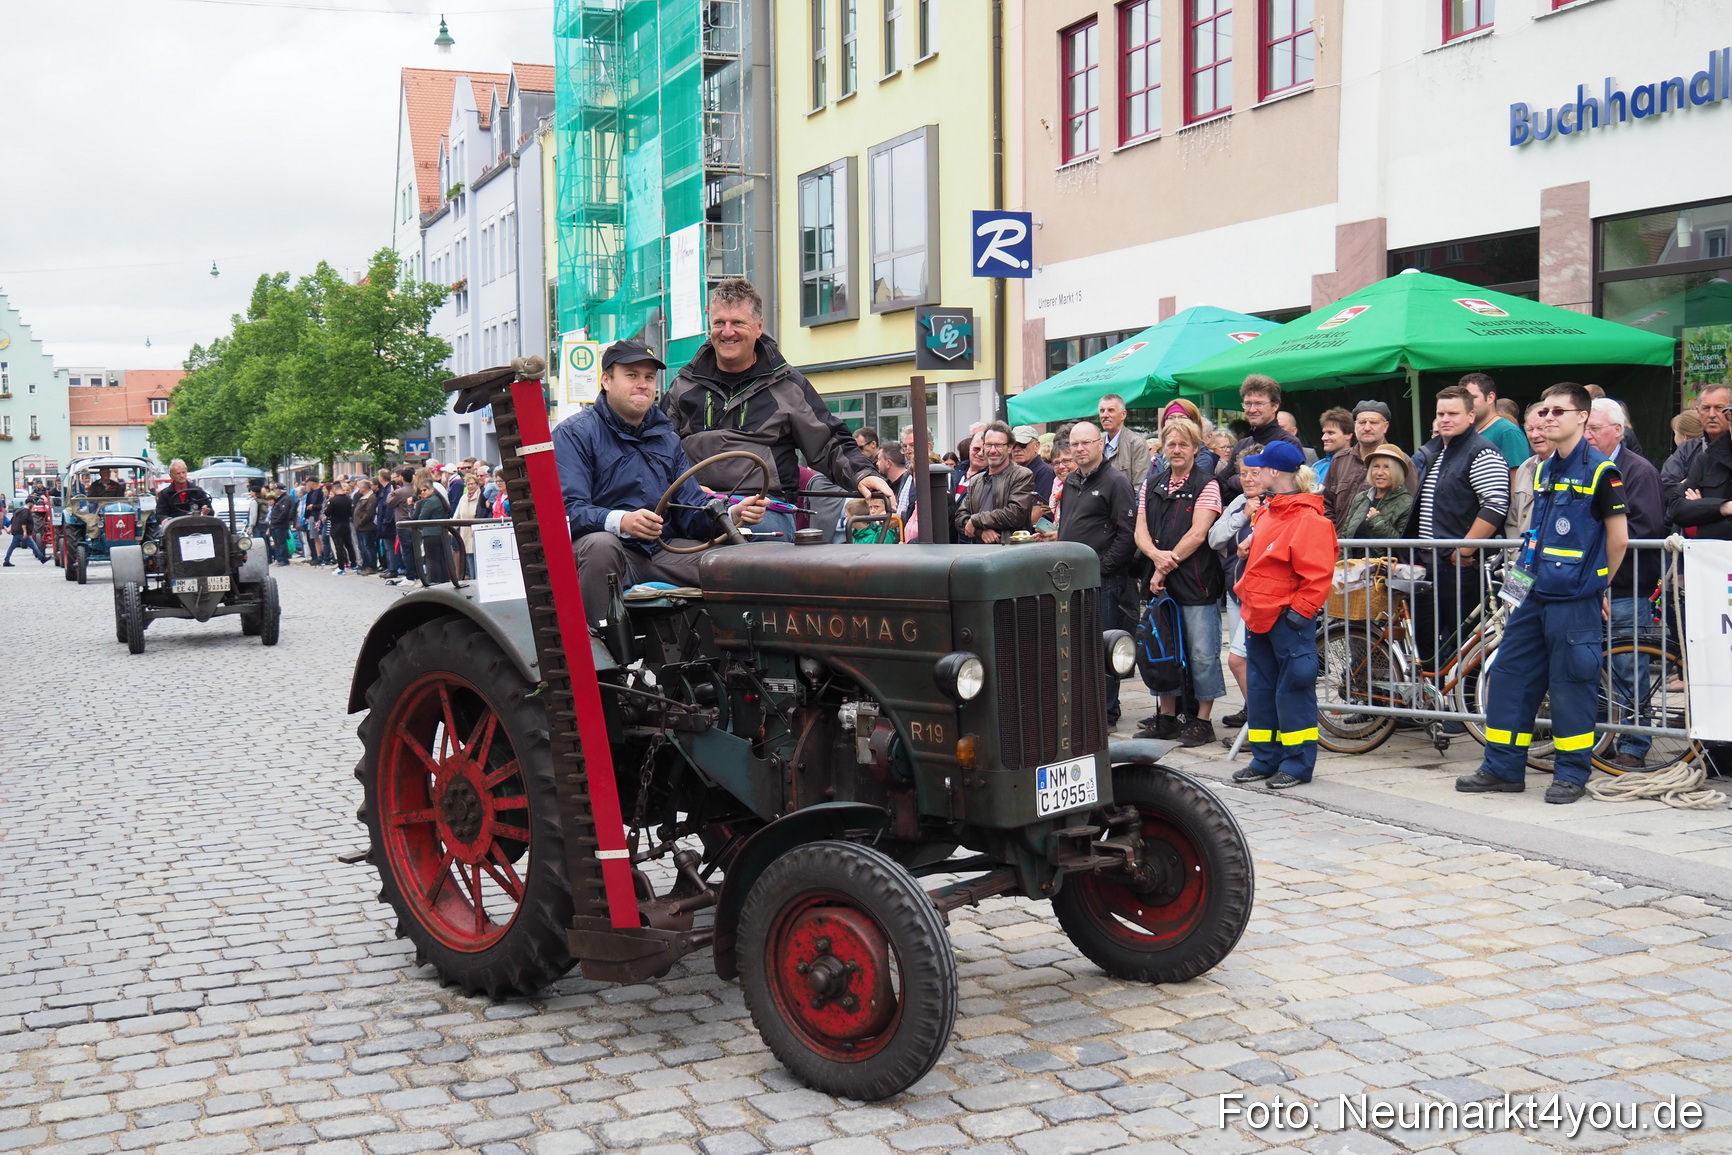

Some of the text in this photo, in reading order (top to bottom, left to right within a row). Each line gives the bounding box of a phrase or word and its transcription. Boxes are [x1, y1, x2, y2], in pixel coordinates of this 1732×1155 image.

[1038, 290, 1082, 309] Unterer Markt 15
[940, 324, 959, 349] G2
[1688, 344, 1709, 352] Wald-
[1692, 353, 1723, 361] Wiesen-
[1688, 362, 1726, 371] Kochbuch
[761, 611, 918, 642] HANOMAG
[1059, 601, 1069, 750] HANOMAG
[1049, 766, 1067, 789] NM
